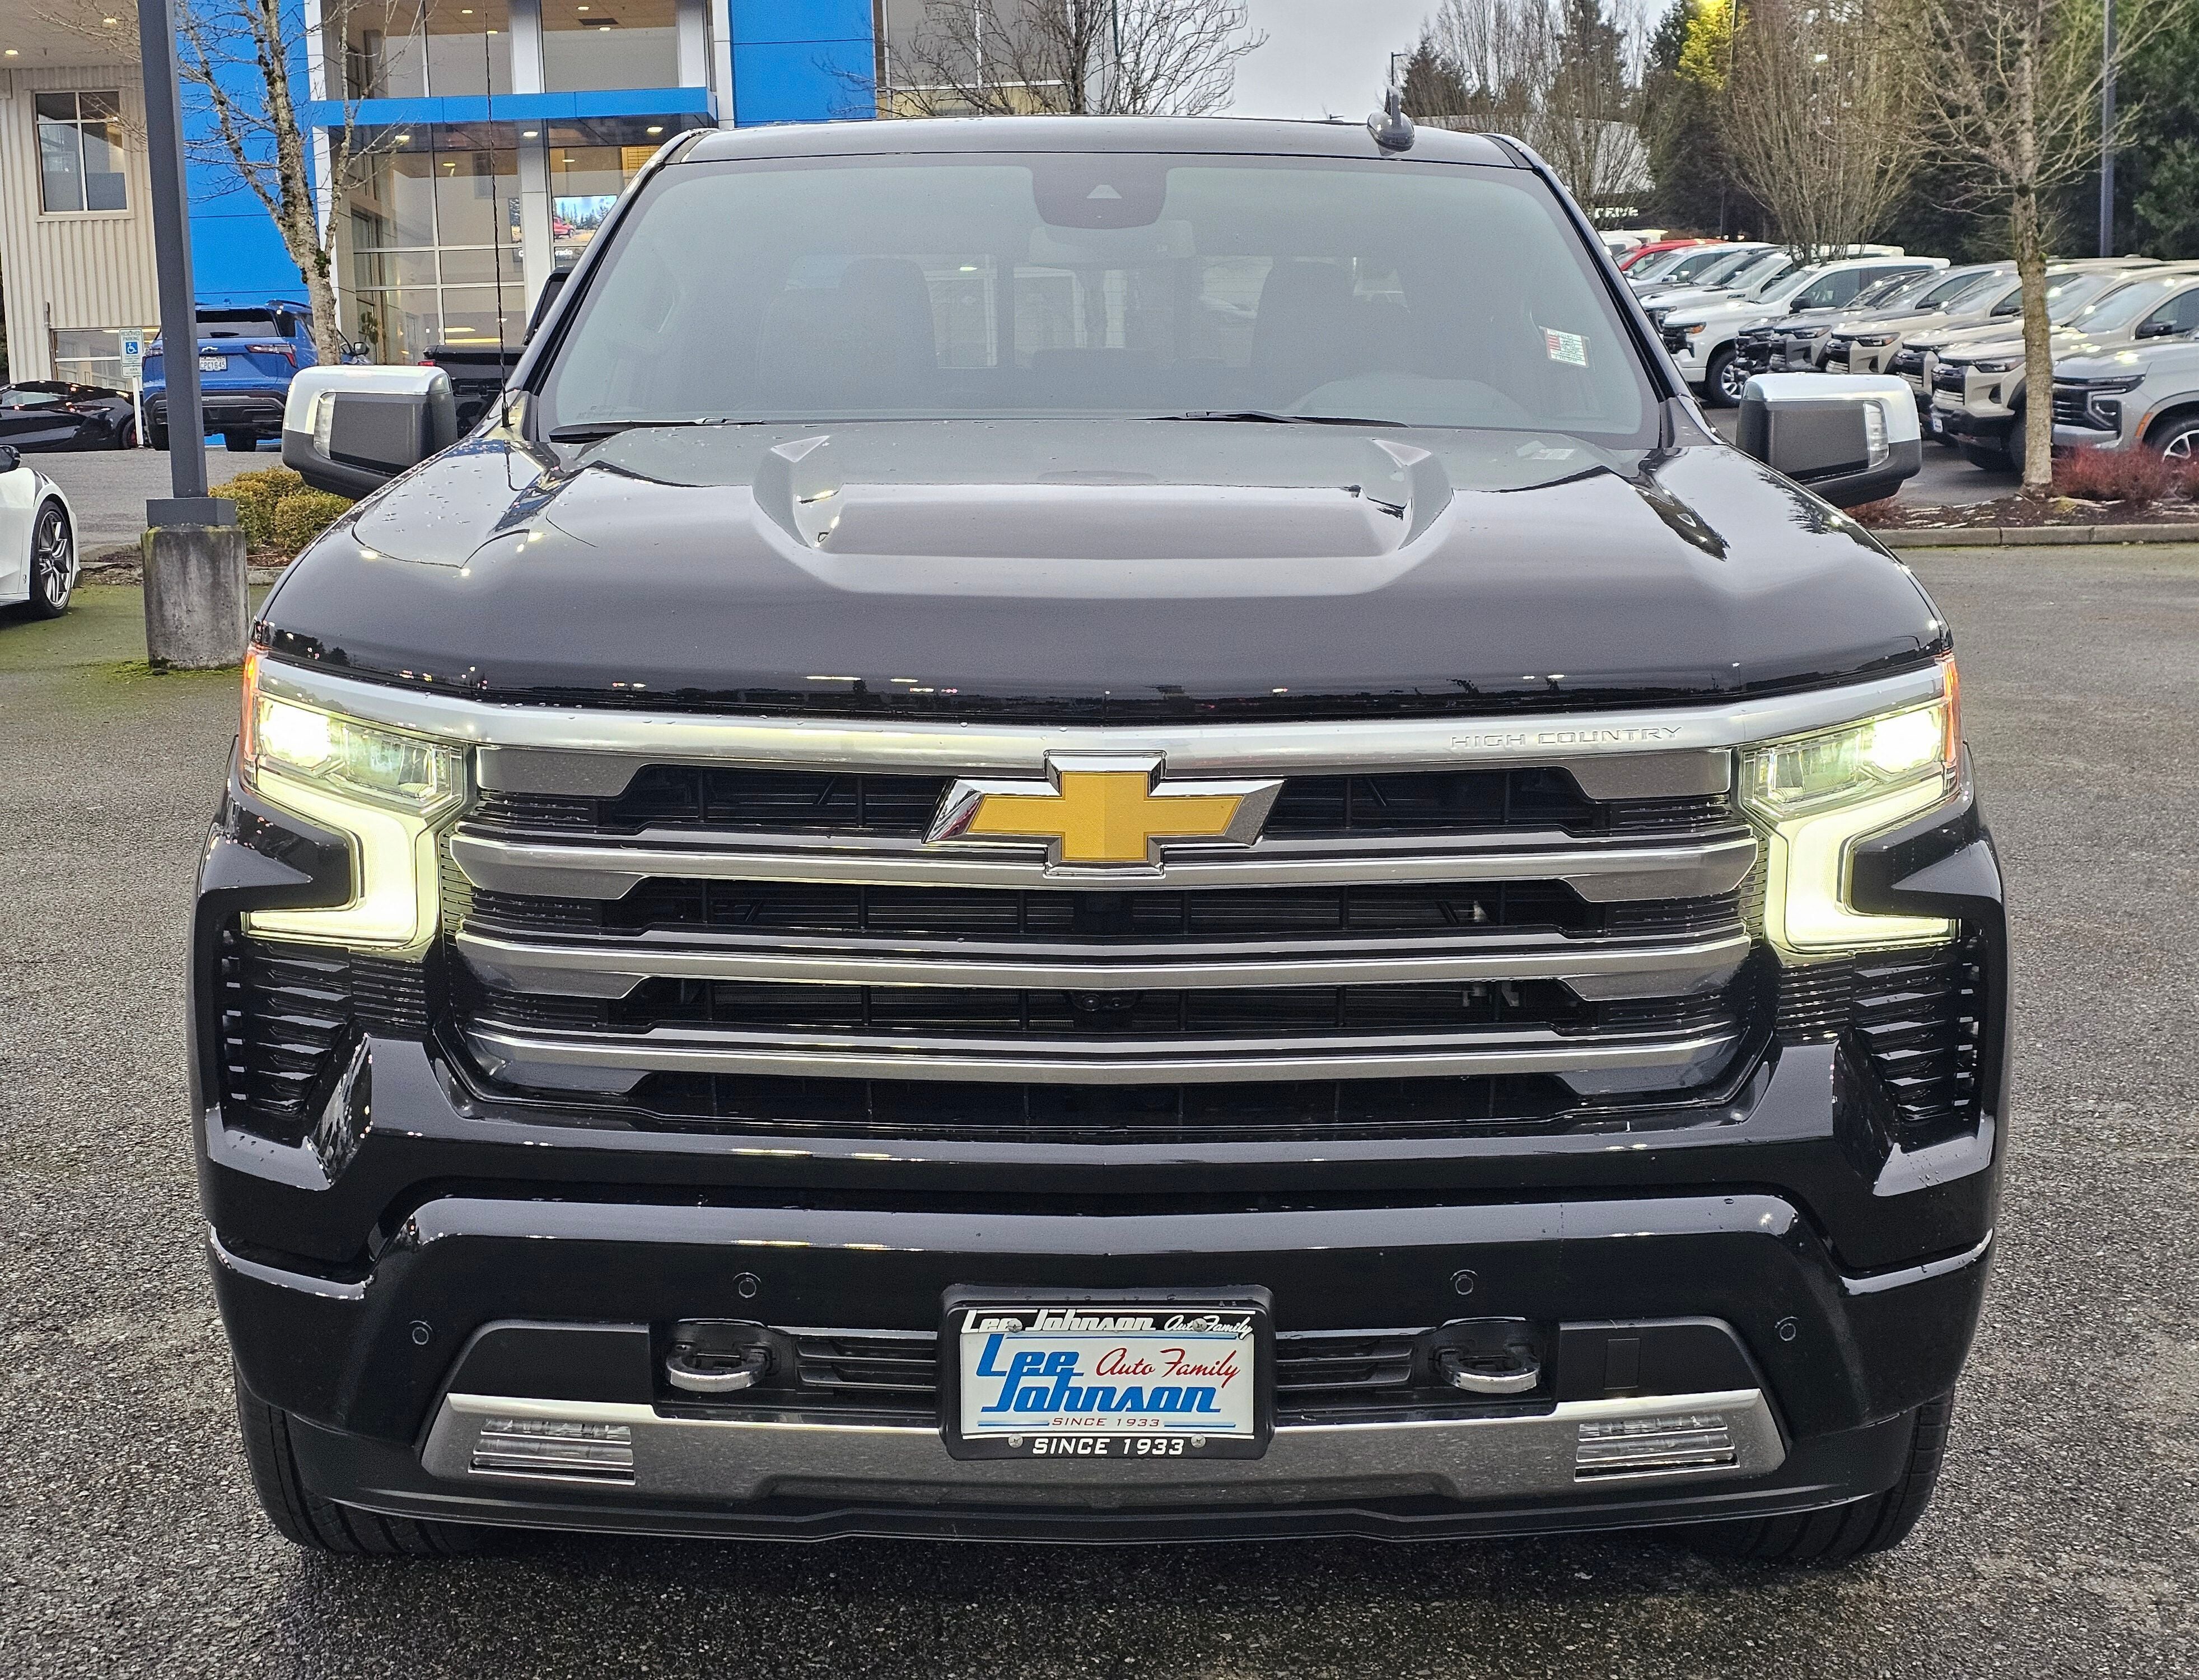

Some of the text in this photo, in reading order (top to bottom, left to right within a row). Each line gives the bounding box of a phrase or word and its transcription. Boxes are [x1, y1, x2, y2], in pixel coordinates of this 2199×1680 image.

[1451, 726, 1682, 749] HIGH COUNTRY
[1025, 1309, 1156, 1332] Johnson
[1164, 1314, 1204, 1332] Aut
[1203, 1315, 1253, 1340] Family
[976, 1333, 1241, 1389] Lee Auto Family
[981, 1369, 1221, 1412] Johnson
[1052, 1417, 1160, 1427] SINCE 1933
[1032, 1438, 1184, 1455] SINCE 1933
